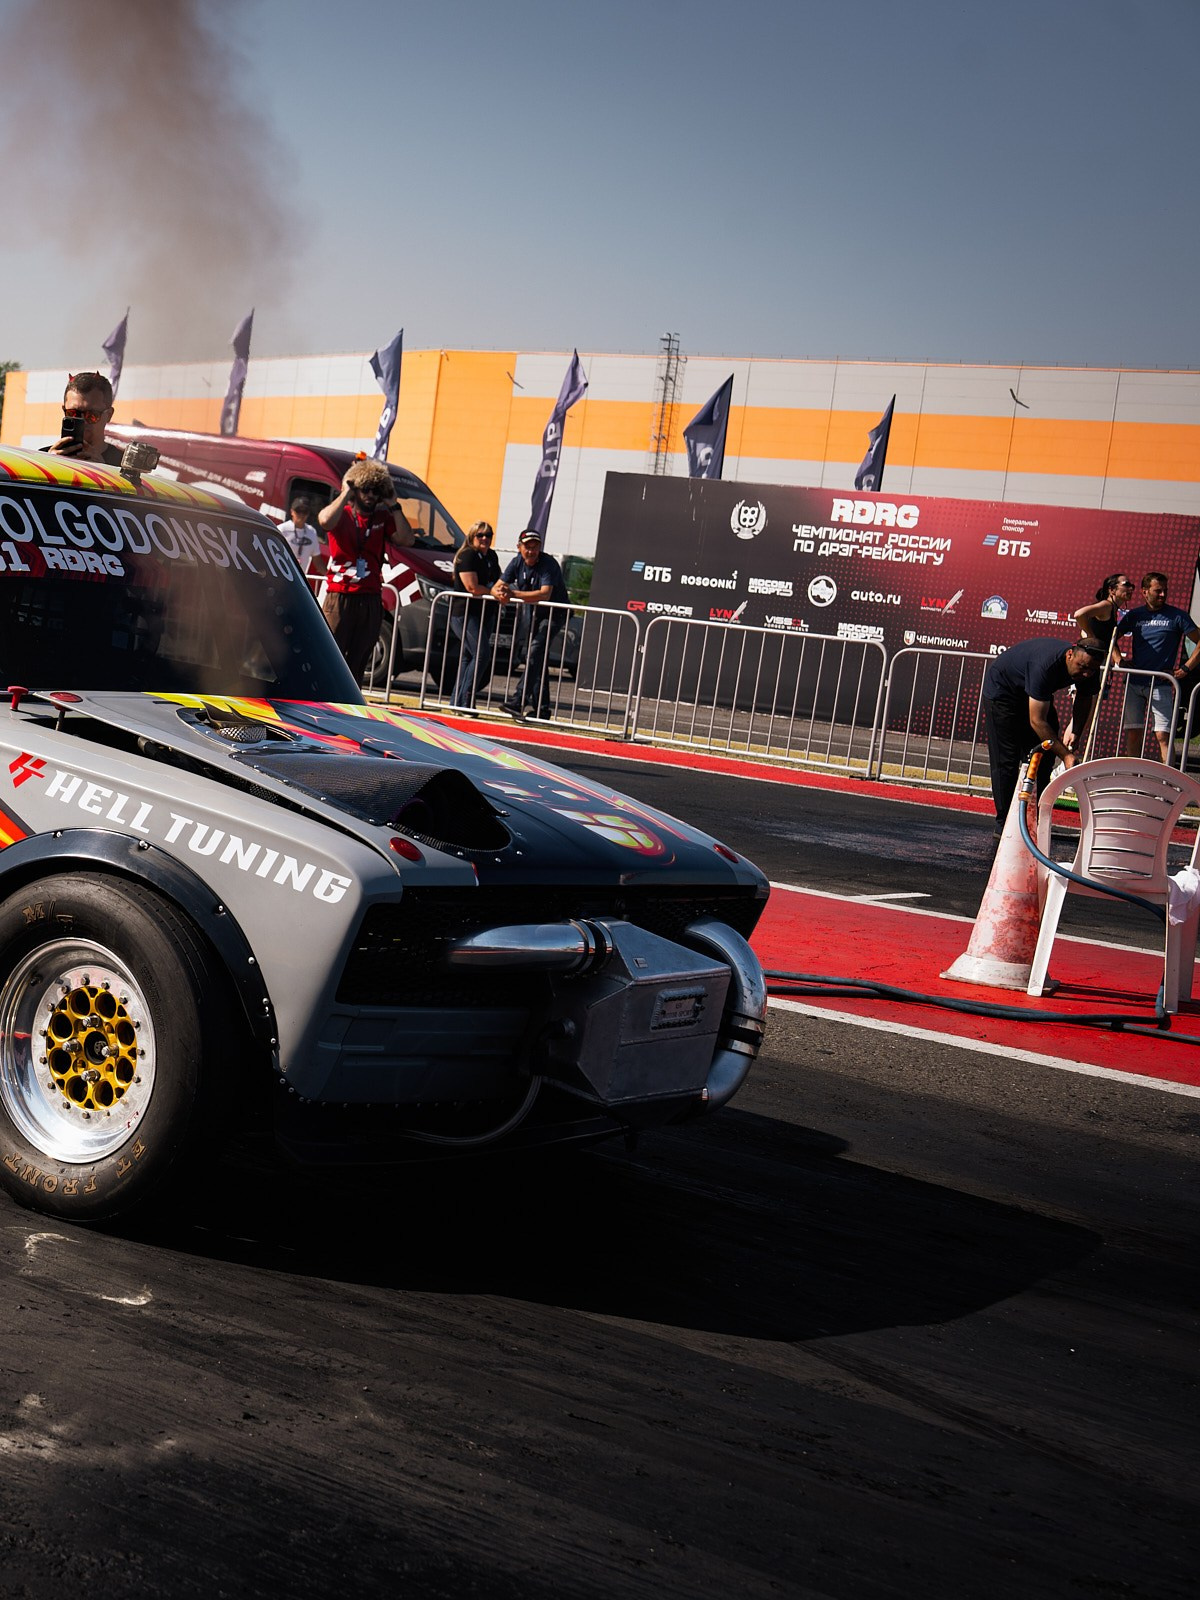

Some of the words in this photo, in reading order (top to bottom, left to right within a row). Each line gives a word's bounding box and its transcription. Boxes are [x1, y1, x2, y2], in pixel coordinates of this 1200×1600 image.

[830, 498, 920, 529] RDRC
[1002, 525, 1025, 533] спонсор
[1003, 517, 1039, 527] Генеральный
[792, 524, 883, 545] ЧЕМПИОНАТ
[887, 533, 952, 551] РОССИИ
[793, 539, 814, 553] ПО
[818, 542, 944, 566] ДРЭГ-РЕЙСИНГУ
[997, 539, 1031, 557] ВТБ
[38, 546, 125, 577] RDRC
[251, 533, 307, 588] 161
[643, 565, 672, 583] ВТБ
[680, 574, 737, 590] ROSGONKI
[748, 578, 793, 589] МОСОБЛ
[851, 589, 901, 605] auto.ru
[647, 602, 693, 616] GORACE
[1026, 609, 1077, 622] VISSOL
[765, 615, 809, 628] VISSOL
[838, 622, 884, 635] МОСОБЛ
[1025, 617, 1049, 625] FORGED
[1051, 619, 1076, 627] WHEELS
[916, 634, 969, 649] ЧЕМПИОНАТ
[44, 769, 157, 835] HELL
[164, 811, 353, 904] TUNING
[2, 1152, 98, 1196] FRONT
